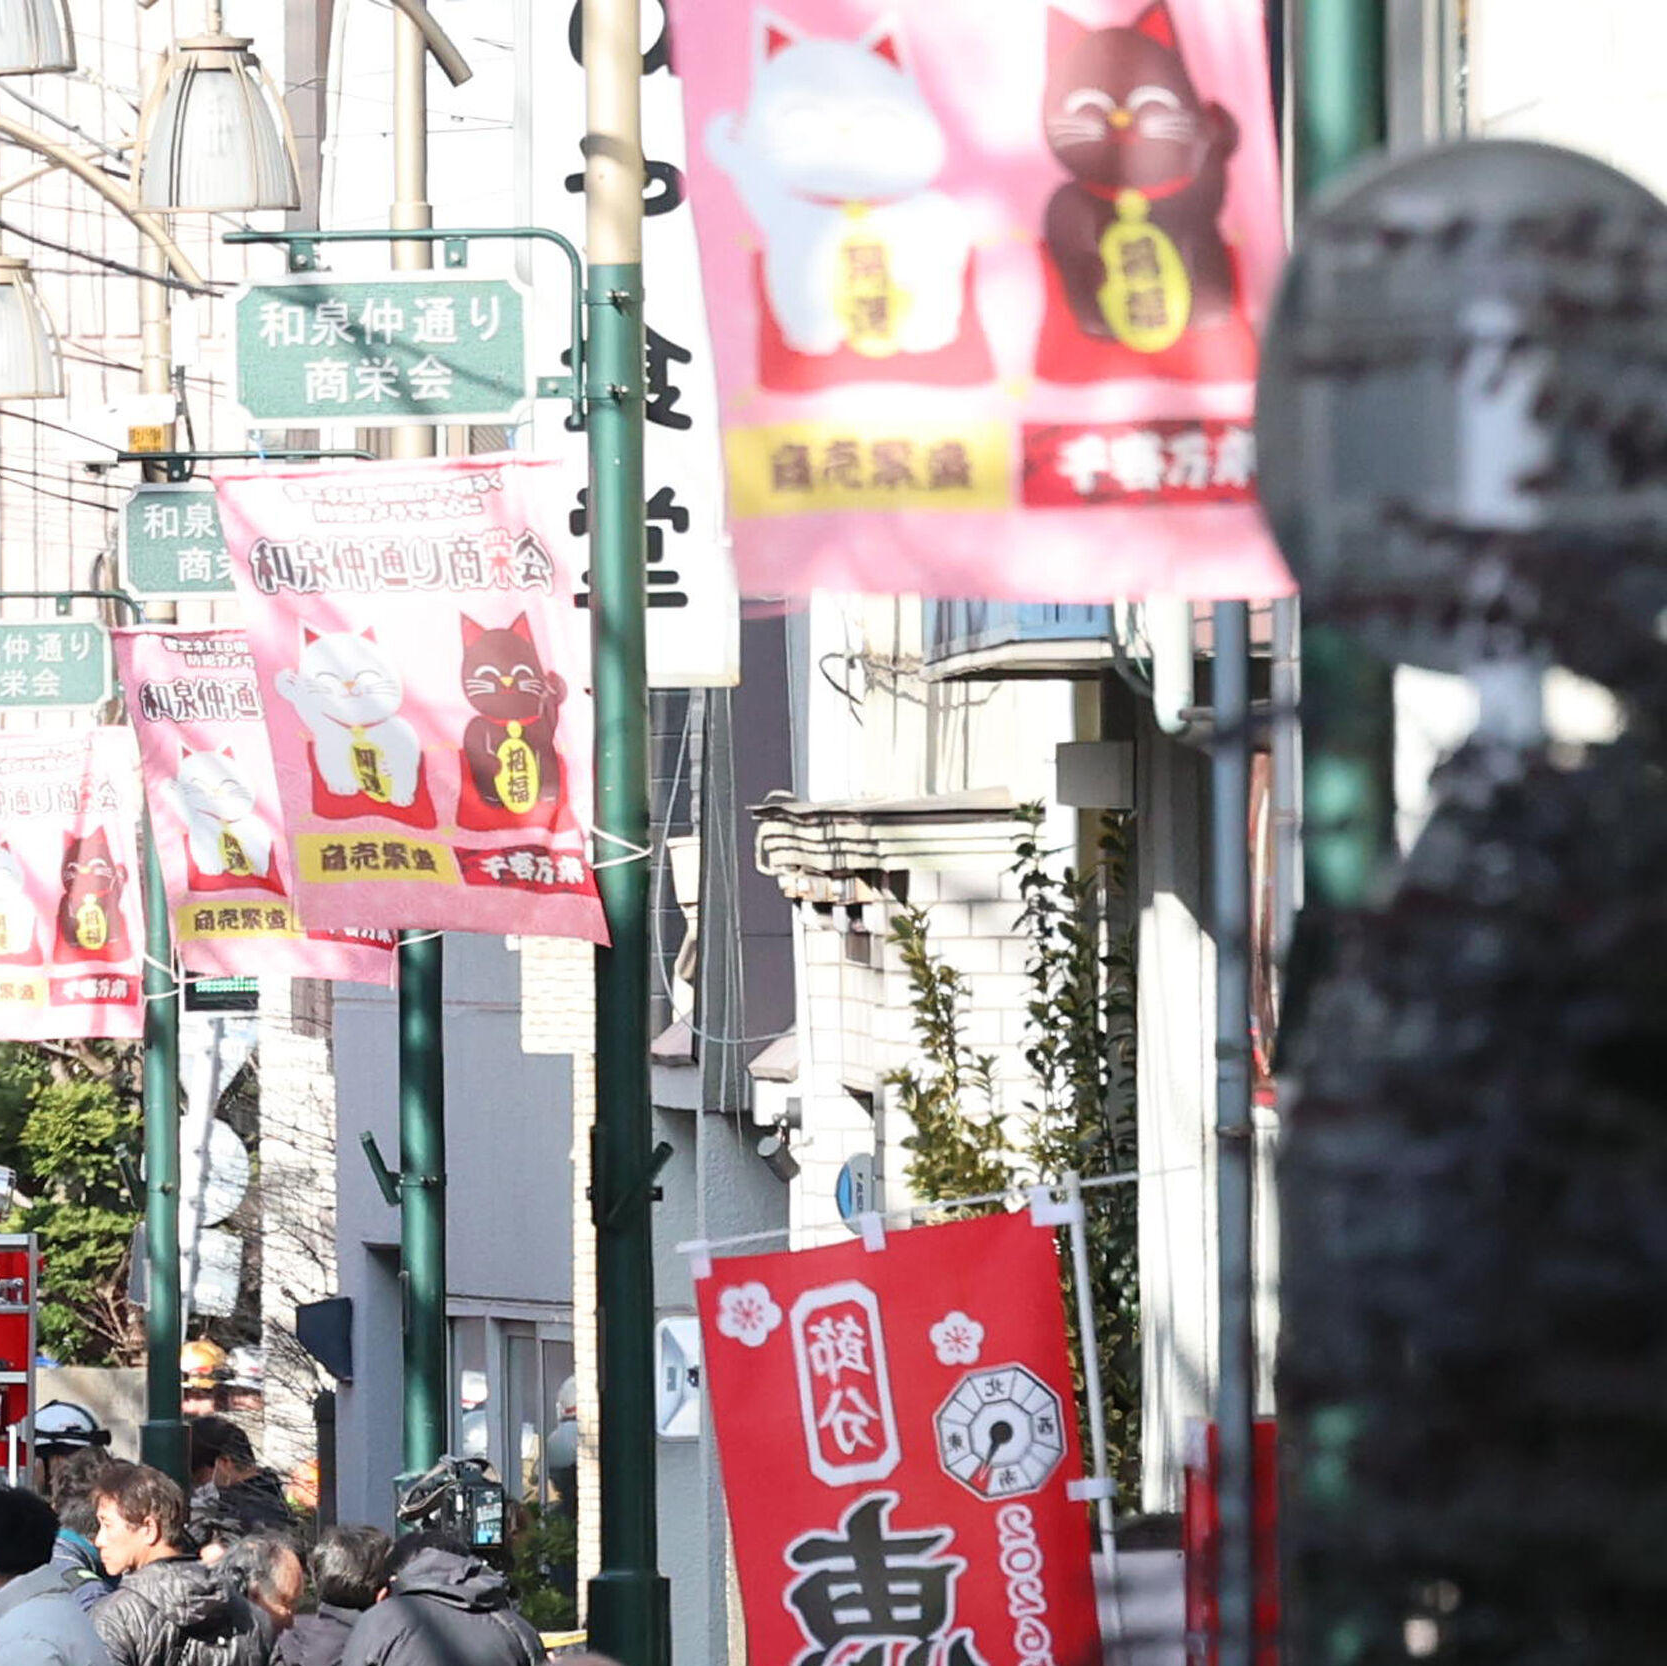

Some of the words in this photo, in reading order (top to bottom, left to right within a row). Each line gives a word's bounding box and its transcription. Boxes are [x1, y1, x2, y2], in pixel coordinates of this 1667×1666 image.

[258, 295, 501, 347] 和泉仲通り
[304, 354, 453, 404] 商栄会
[248, 528, 554, 596] 和泉仲通り商栄会
